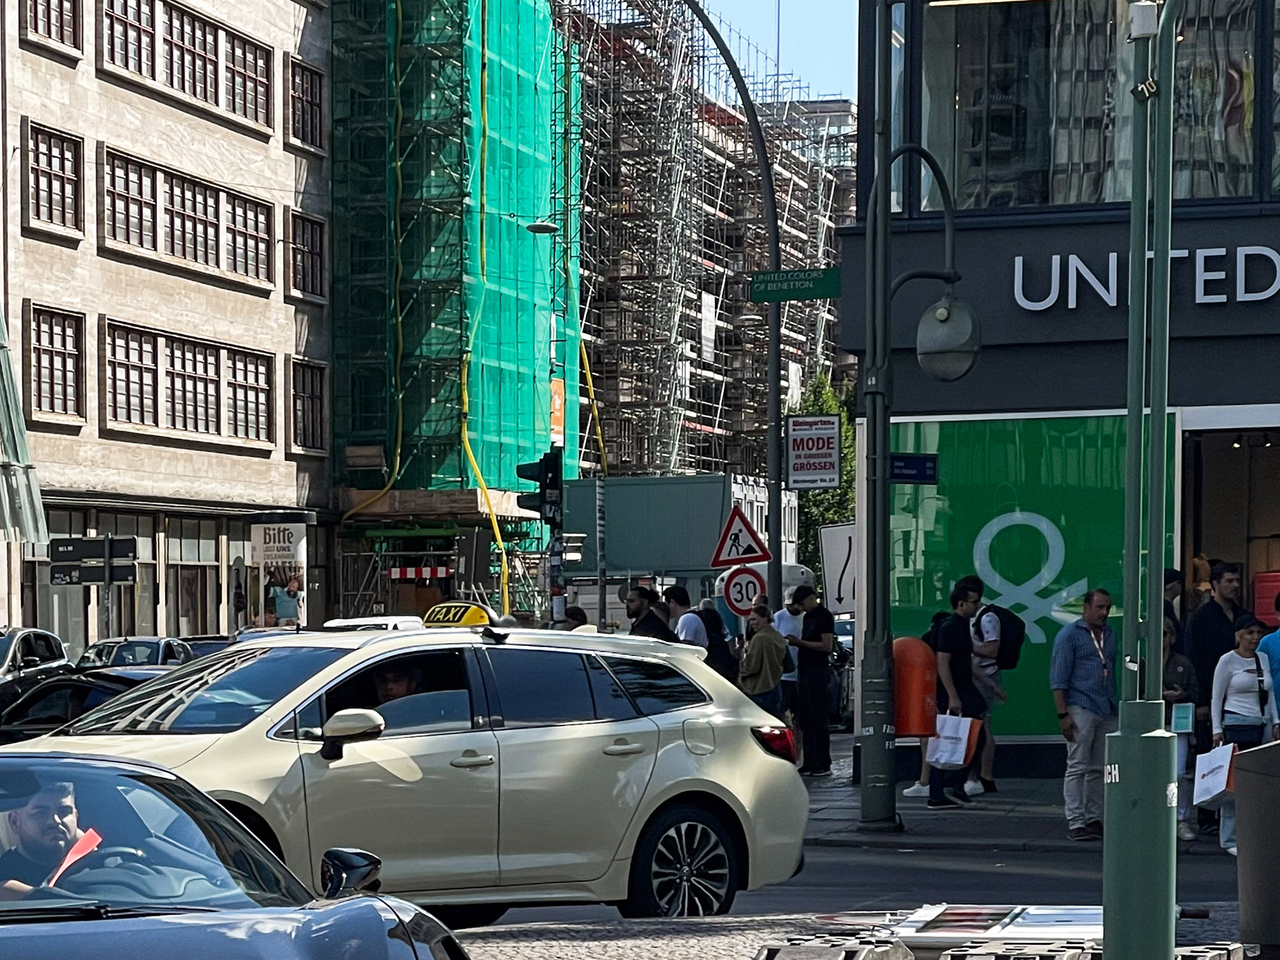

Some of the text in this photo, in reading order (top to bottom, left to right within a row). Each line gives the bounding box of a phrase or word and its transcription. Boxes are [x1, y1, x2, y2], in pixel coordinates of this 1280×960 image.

[754, 271, 824, 281] UNITED COLORS
[1014, 246, 1280, 311] UNED
[754, 281, 814, 291] OF BENETTON
[792, 437, 835, 451] MODE
[793, 461, 835, 472] GRÖSSEN
[263, 527, 294, 544] Bitte
[733, 581, 757, 603] 30
[430, 607, 466, 621] TAXI
